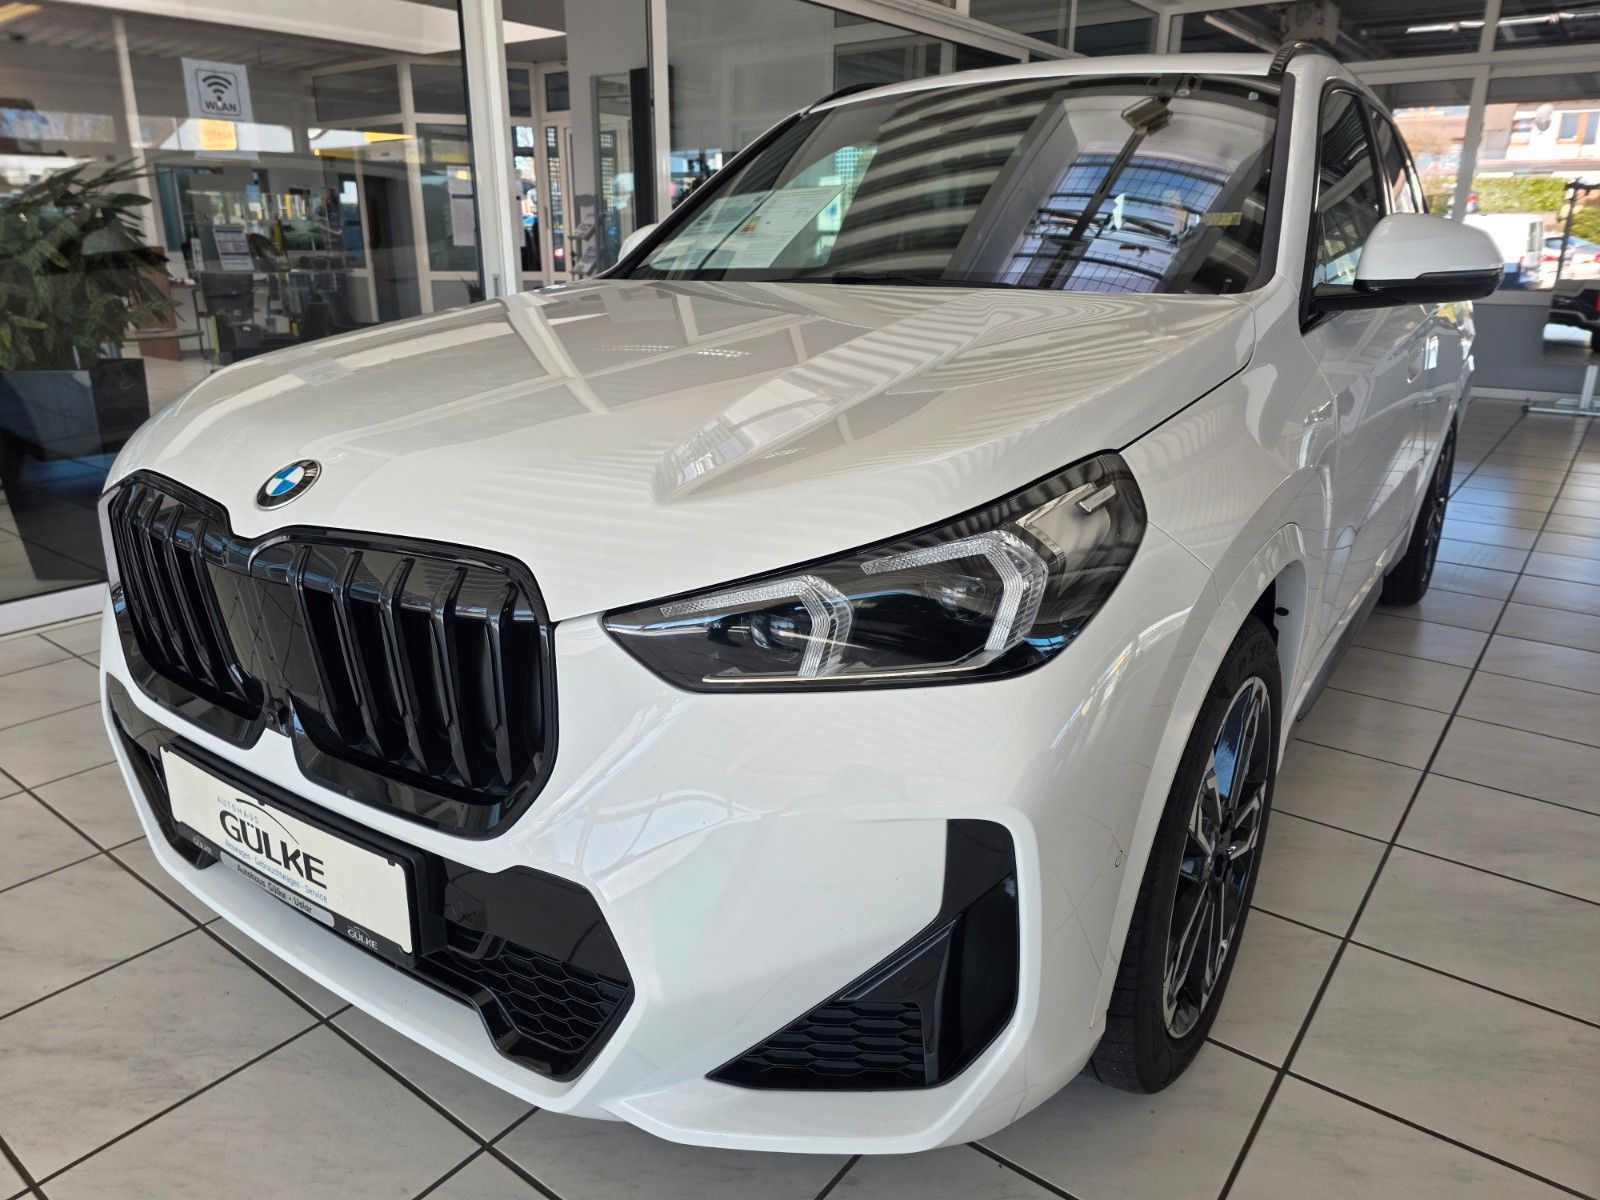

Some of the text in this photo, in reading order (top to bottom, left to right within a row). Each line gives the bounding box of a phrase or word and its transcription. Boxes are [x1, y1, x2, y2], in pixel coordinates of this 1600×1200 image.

[205, 101, 238, 112] WLAN
[217, 796, 260, 824] AUTOHAUS
[219, 809, 328, 890] GÜLKE
[237, 863, 313, 914] Autohaus Gülke Uslar
[304, 884, 329, 904] Service
[347, 928, 379, 951] GÜLKE
